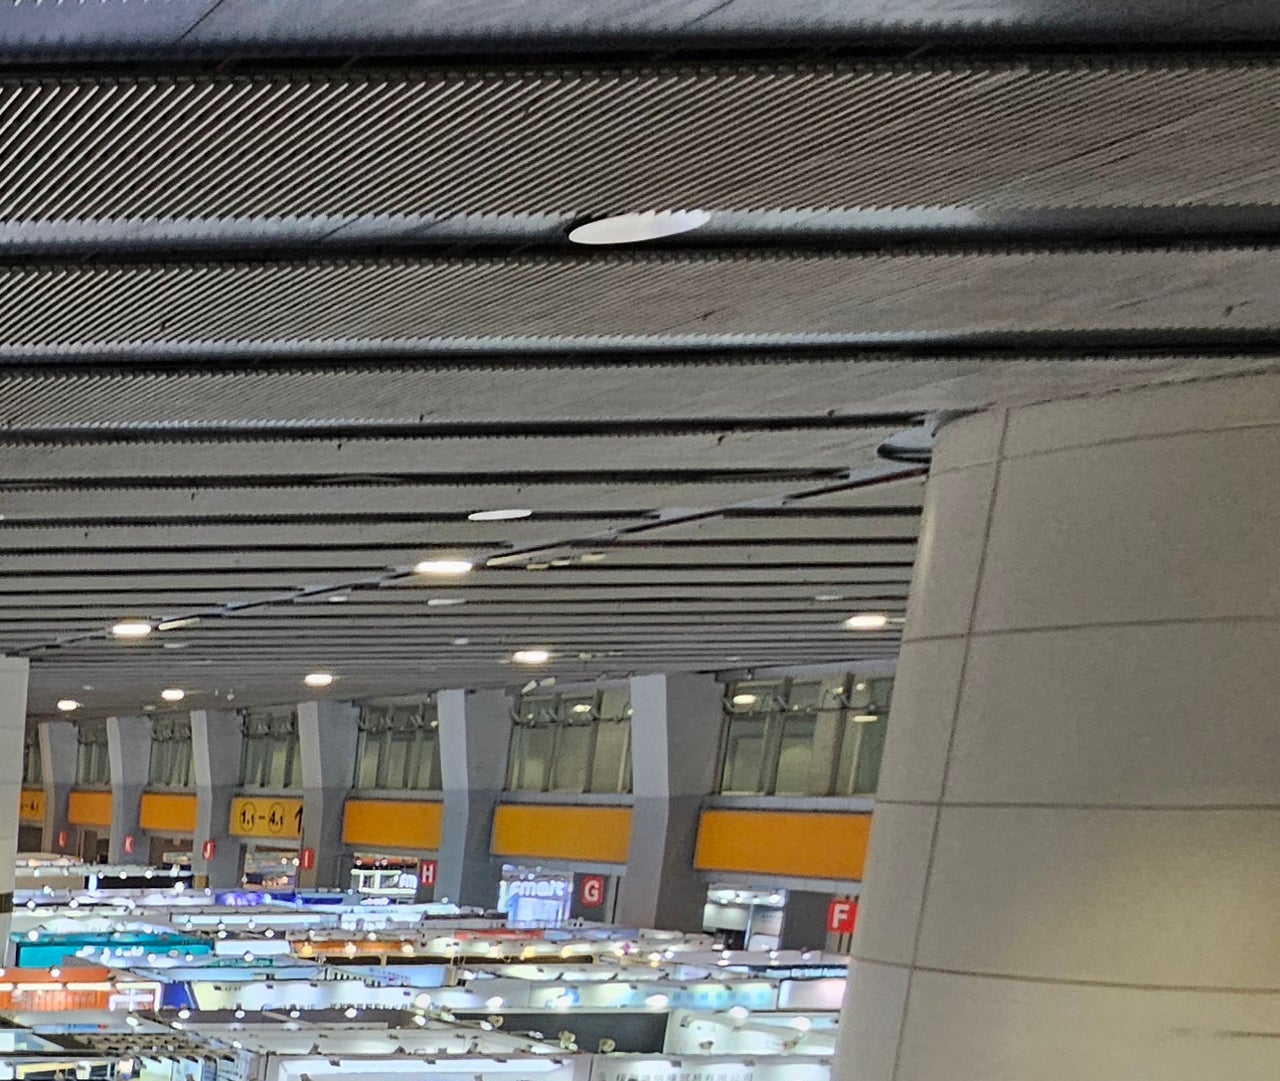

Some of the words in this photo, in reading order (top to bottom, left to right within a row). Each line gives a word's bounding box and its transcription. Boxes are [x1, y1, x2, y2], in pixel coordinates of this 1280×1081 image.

[423, 864, 435, 883] H
[584, 880, 600, 902] G
[832, 903, 850, 929] F
